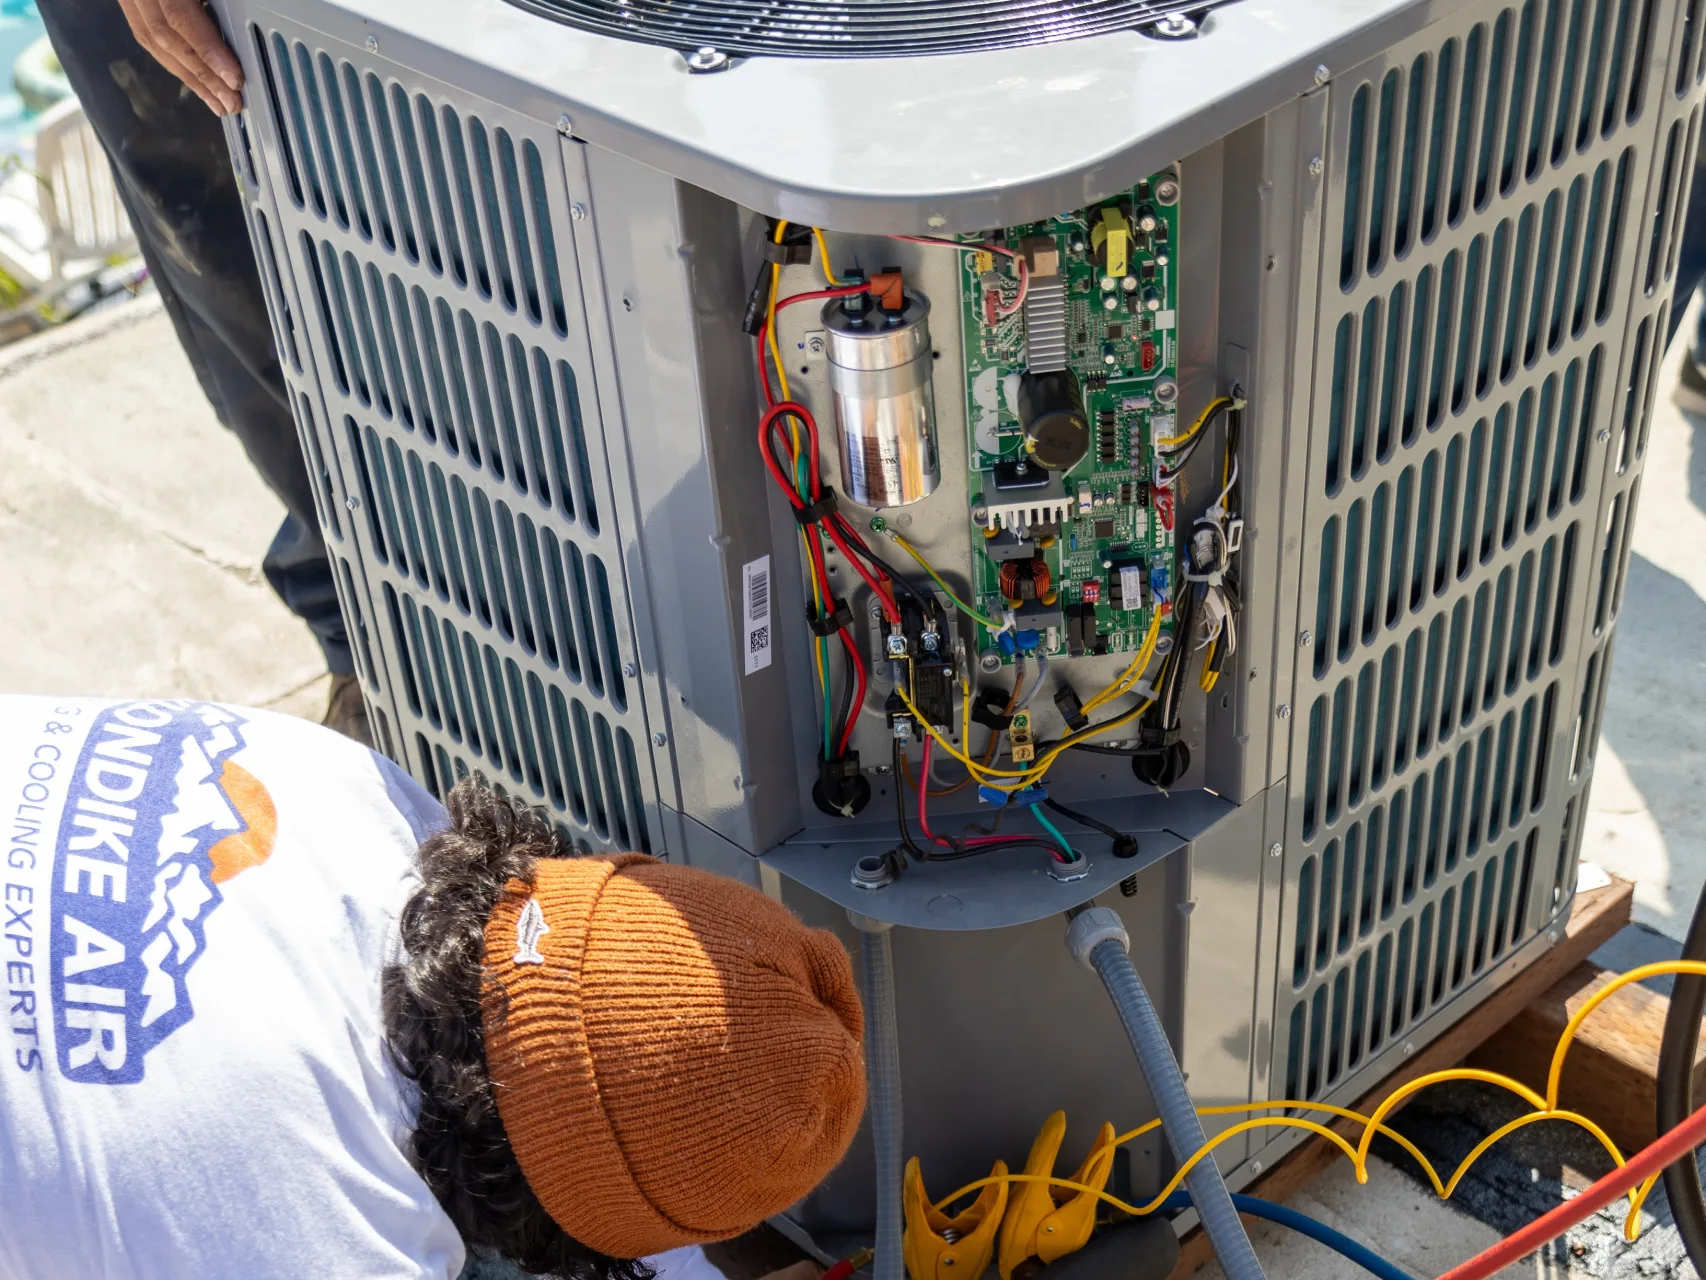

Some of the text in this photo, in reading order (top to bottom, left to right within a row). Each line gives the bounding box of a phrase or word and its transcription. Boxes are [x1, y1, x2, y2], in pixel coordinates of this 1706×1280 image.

[44, 721, 73, 735] &
[8, 744, 62, 870] COOLING
[5, 882, 43, 1073] EXPERTS
[63, 914, 128, 1070] AIR
